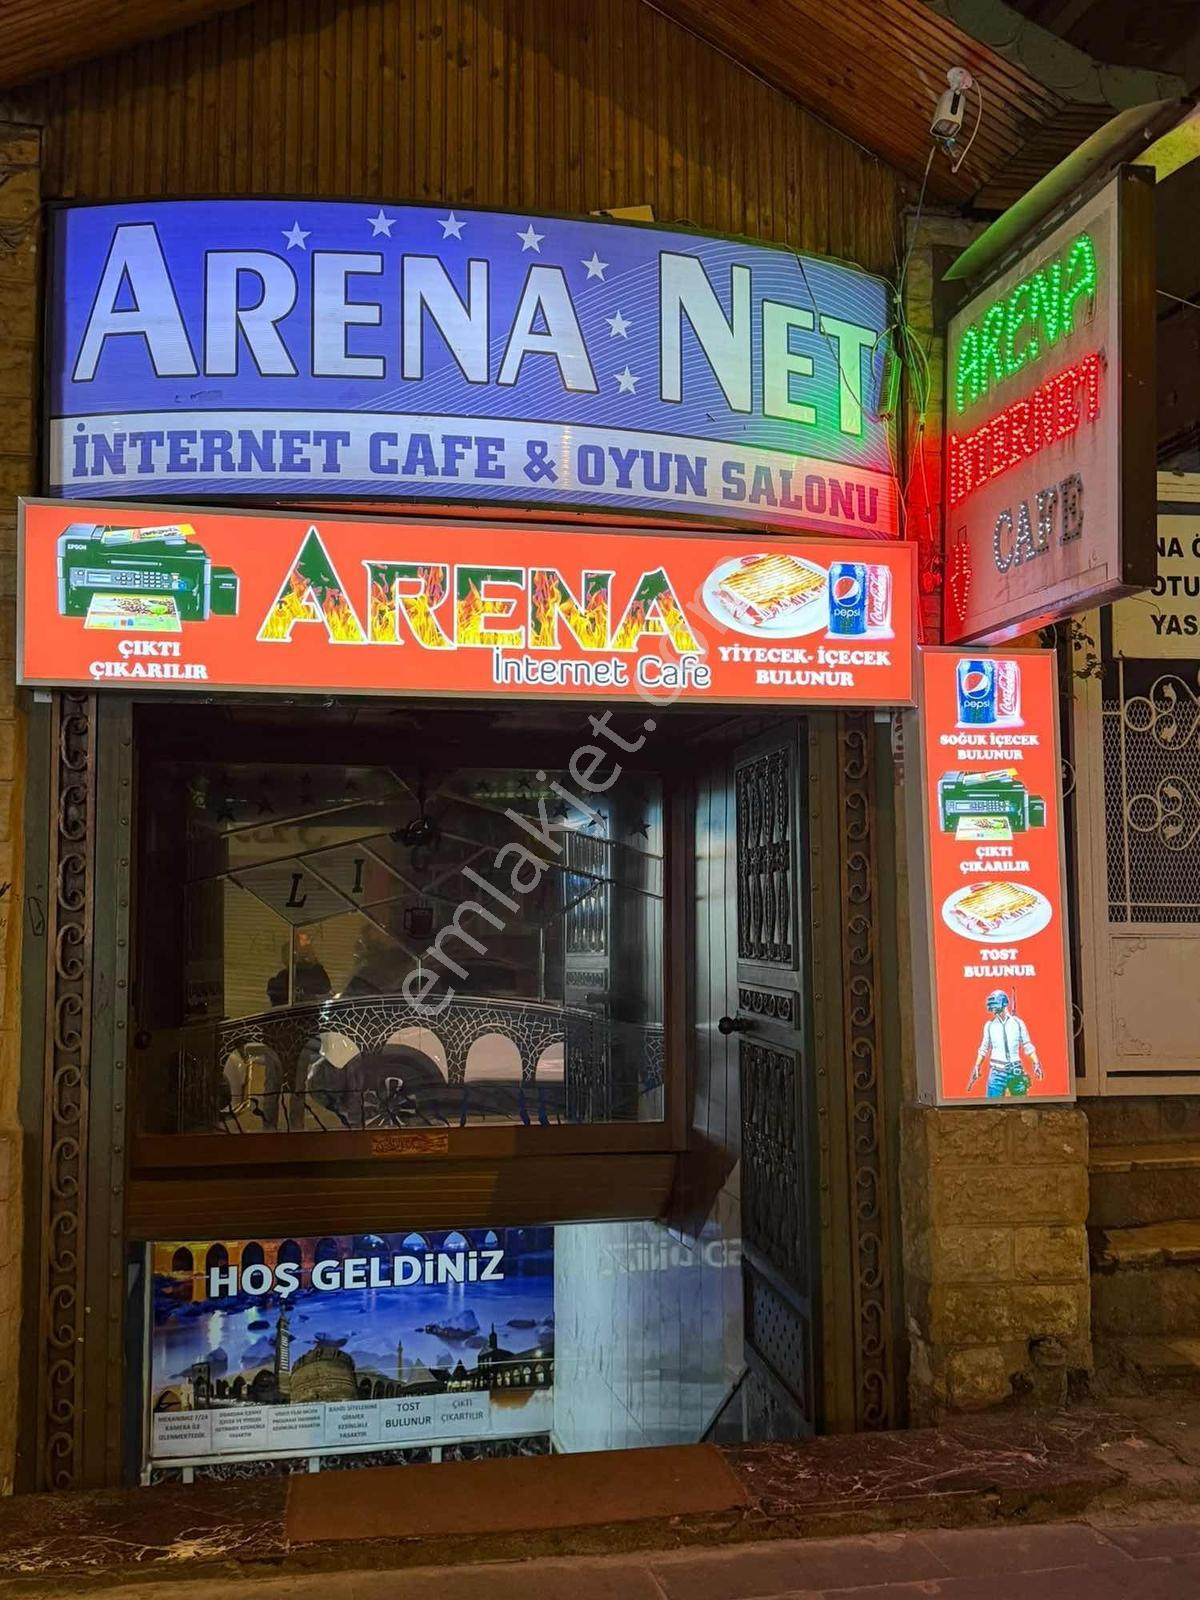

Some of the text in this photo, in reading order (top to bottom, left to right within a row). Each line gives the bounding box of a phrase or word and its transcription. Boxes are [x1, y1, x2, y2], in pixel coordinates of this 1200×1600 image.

[71, 221, 878, 437] ARENA NET
[955, 232, 1095, 415] ARENA
[72, 422, 879, 524] İNTERNET CAFE & OYUN SALONU
[993, 473, 1084, 574] CAFE
[256, 525, 705, 655] ARENA
[834, 608, 861, 619] pepsi
[1150, 614, 1200, 636] YAS
[118, 640, 181, 659] ÇIKTI
[817, 646, 891, 668] İÇECEK
[89, 661, 208, 680] ÇIKARILIR
[492, 646, 712, 689] İnternet Cafe
[756, 670, 855, 686] BULUNUR
[963, 700, 990, 709] pepsi
[940, 731, 1040, 747] SOĞUK İÇECEK
[957, 749, 1023, 760] BULUNUR
[976, 846, 1013, 860] ÇIKTI
[960, 861, 1030, 874] ÇIKARILIR
[980, 948, 1018, 960] TOST
[963, 964, 1036, 977] BULUNUR
[209, 1262, 300, 1299] HOŞ
[397, 1401, 421, 1412] TOST
[385, 1416, 432, 1428] BULUNUR
